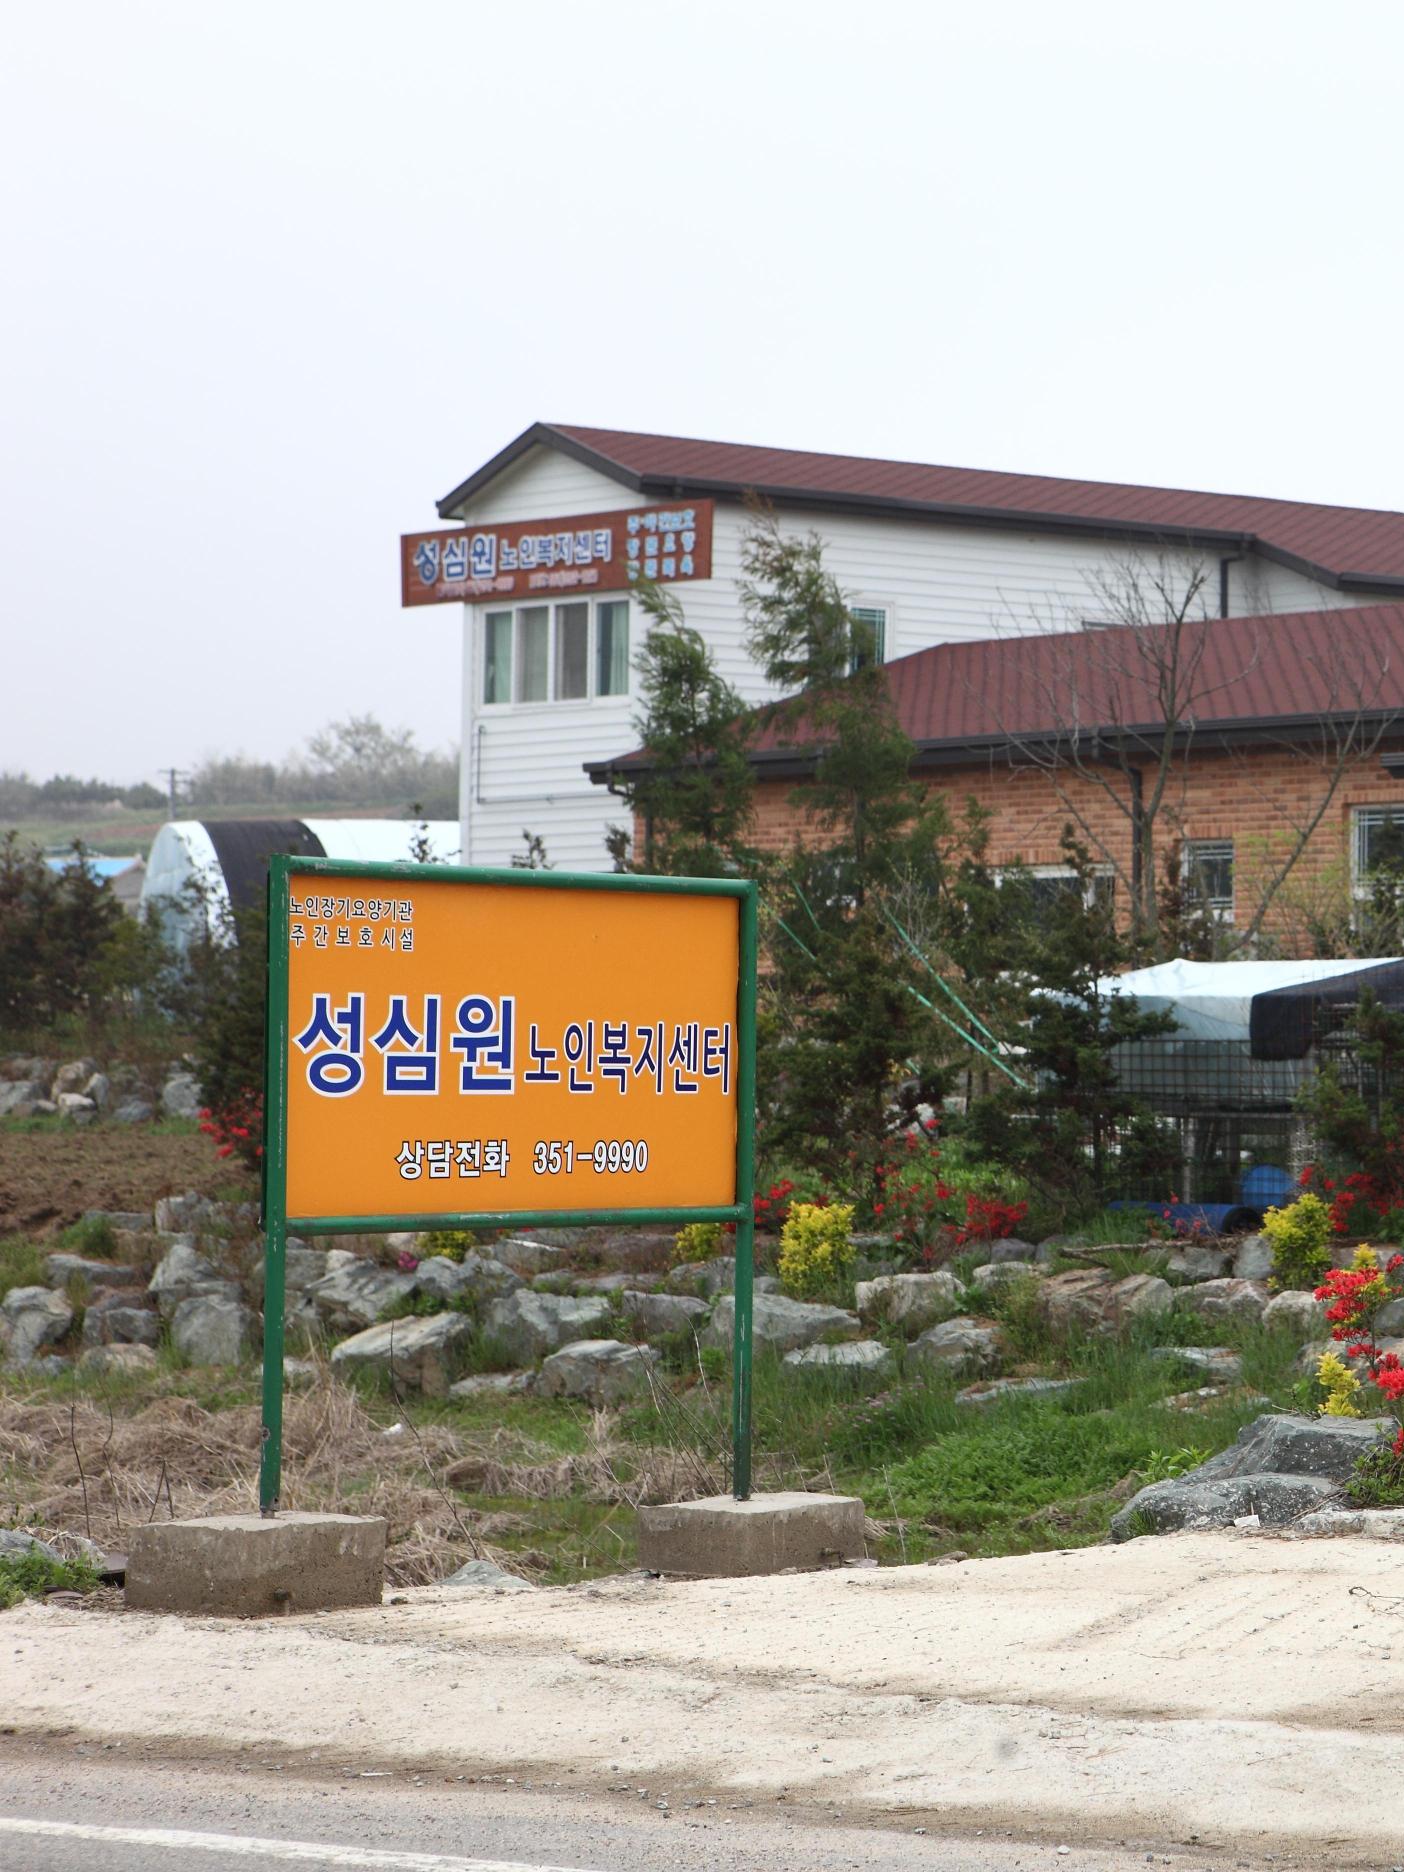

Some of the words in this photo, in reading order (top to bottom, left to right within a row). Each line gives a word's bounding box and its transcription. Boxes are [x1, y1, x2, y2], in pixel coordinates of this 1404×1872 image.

[413, 533, 496, 585] 성심원
[500, 529, 612, 570] 노인복지센터
[289, 896, 413, 922] 노인장기요양기관
[293, 992, 515, 1098] 성심원
[524, 1021, 731, 1094] 노인복지센터
[396, 1140, 510, 1179] 상담전화
[533, 1140, 649, 1174] 351-9990
